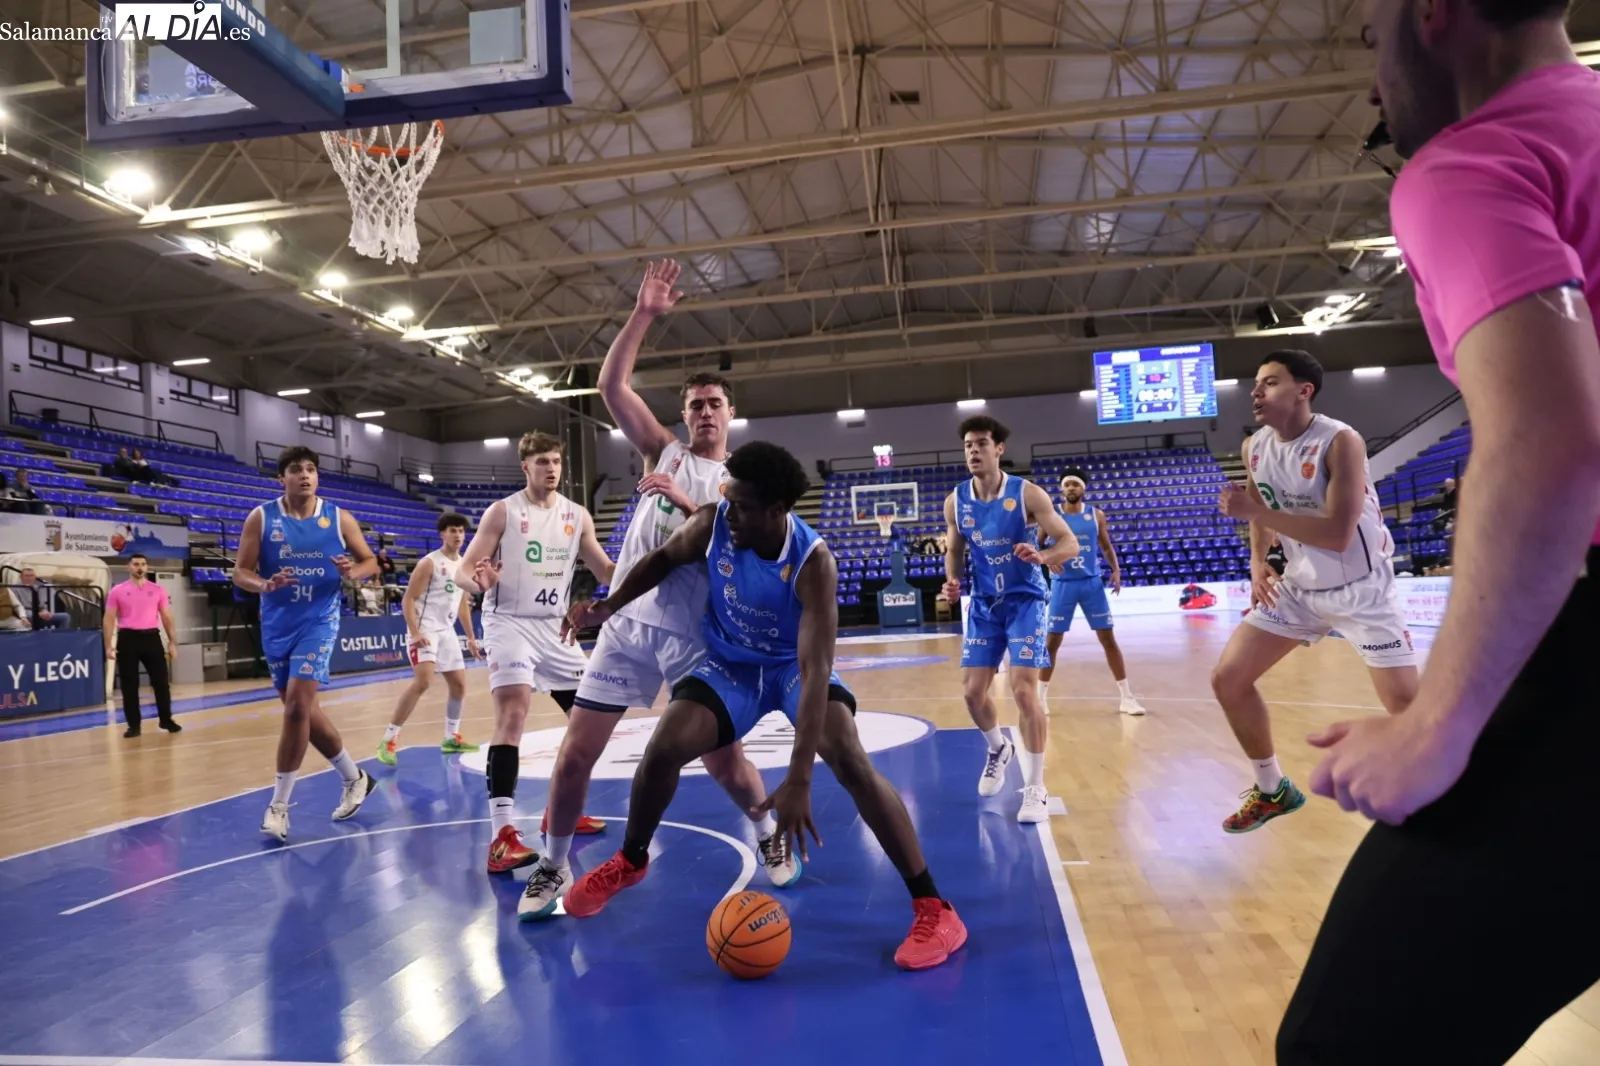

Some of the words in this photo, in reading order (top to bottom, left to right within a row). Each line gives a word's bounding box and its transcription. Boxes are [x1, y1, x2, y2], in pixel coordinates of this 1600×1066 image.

[64, 532, 109, 543] Ayuntamiento
[65, 542, 74, 550] de
[75, 542, 109, 552] Salamanca
[1071, 556, 1085, 569] 22
[290, 584, 313, 603] 34
[534, 588, 558, 606] 46
[340, 635, 388, 652] CASTILLA
[391, 634, 398, 650] Y
[8, 664, 25, 690] Y
[34, 652, 89, 683] LEÓN
[590, 671, 628, 687] ABANCA
